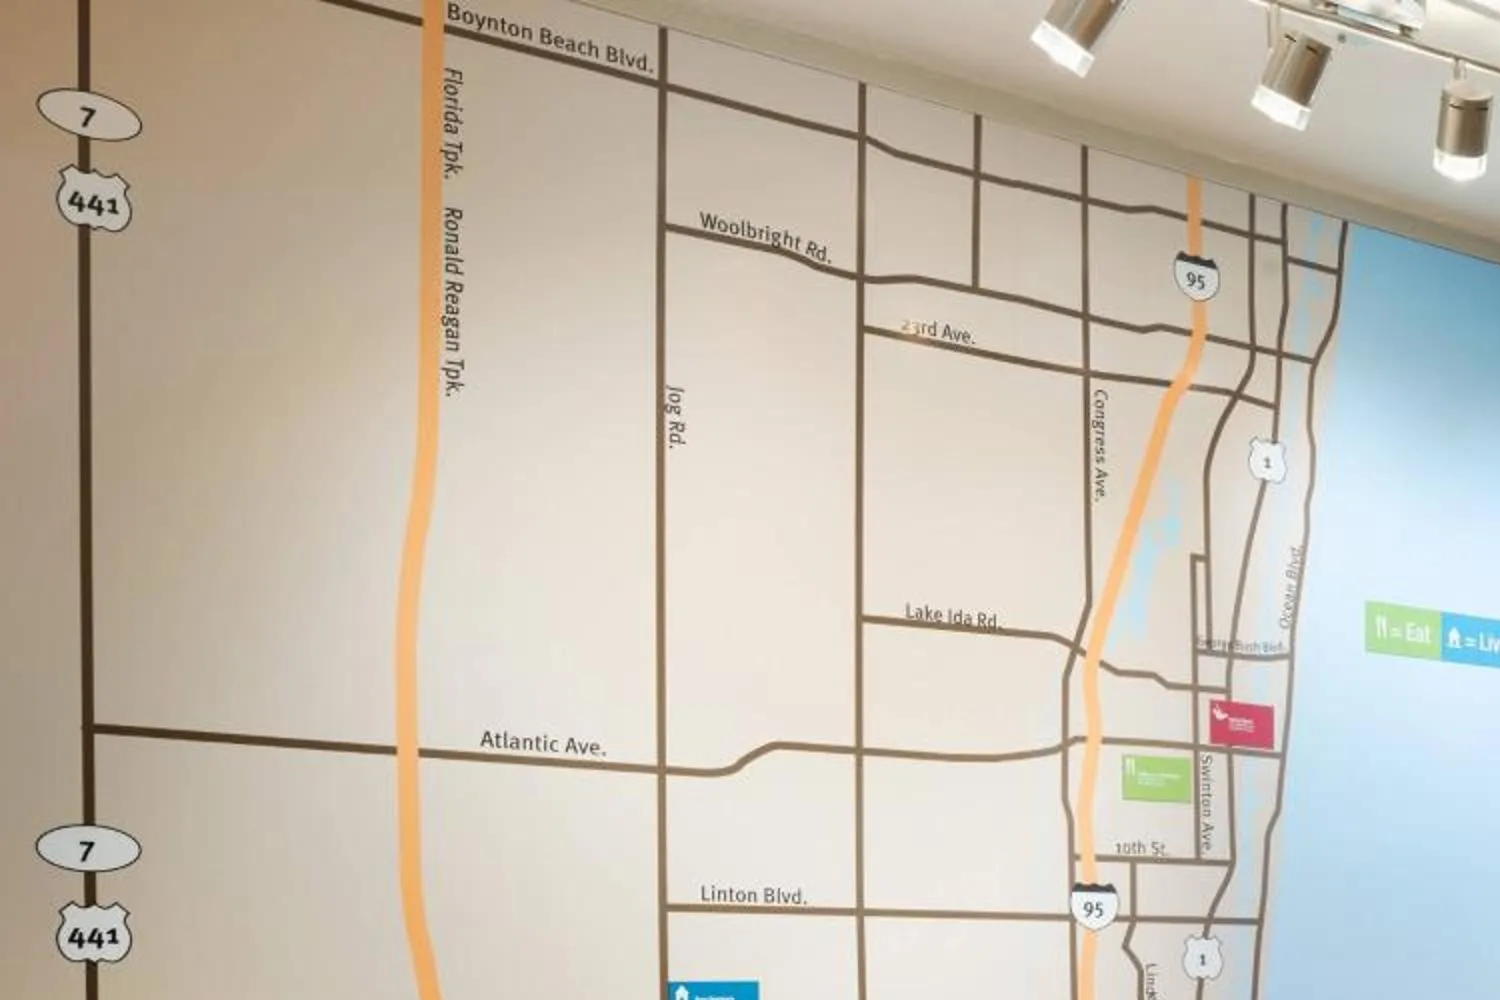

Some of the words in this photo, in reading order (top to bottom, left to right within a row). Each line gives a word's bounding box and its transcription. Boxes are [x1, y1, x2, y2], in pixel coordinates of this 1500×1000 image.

[447, 2, 533, 41] Boynton
[539, 26, 600, 60] Beach
[605, 45, 655, 73] Blvd.
[443, 67, 464, 134] Florida
[79, 107, 96, 128] 7
[440, 139, 465, 180] Tpk.
[68, 190, 119, 217] 441
[444, 206, 465, 275] Ronald
[700, 212, 801, 250] Woolbright
[806, 240, 832, 264] Rd.
[1186, 271, 1206, 290] 95
[442, 280, 464, 352] Reagan
[901, 319, 937, 337] 23rd
[942, 324, 976, 344] Ave.
[442, 356, 466, 397] Tpk.
[664, 385, 684, 416] Jog
[668, 420, 684, 449] Rd.
[1092, 390, 1107, 465] Congress
[1263, 456, 1272, 468] 1
[1094, 468, 1108, 503] Ave.
[905, 602, 943, 622] Lake
[948, 608, 973, 627] Ida
[977, 611, 1002, 632] Rd.
[1406, 623, 1430, 644] Eat
[480, 730, 559, 754] Atlantic
[565, 737, 607, 757] Ave.
[1201, 755, 1213, 817] Swinton
[79, 841, 96, 863] 7
[1115, 840, 1146, 855] 10th
[700, 884, 757, 904] Linton
[763, 886, 808, 905] Blvd.
[1083, 901, 1103, 919] 95
[67, 926, 120, 949] 441
